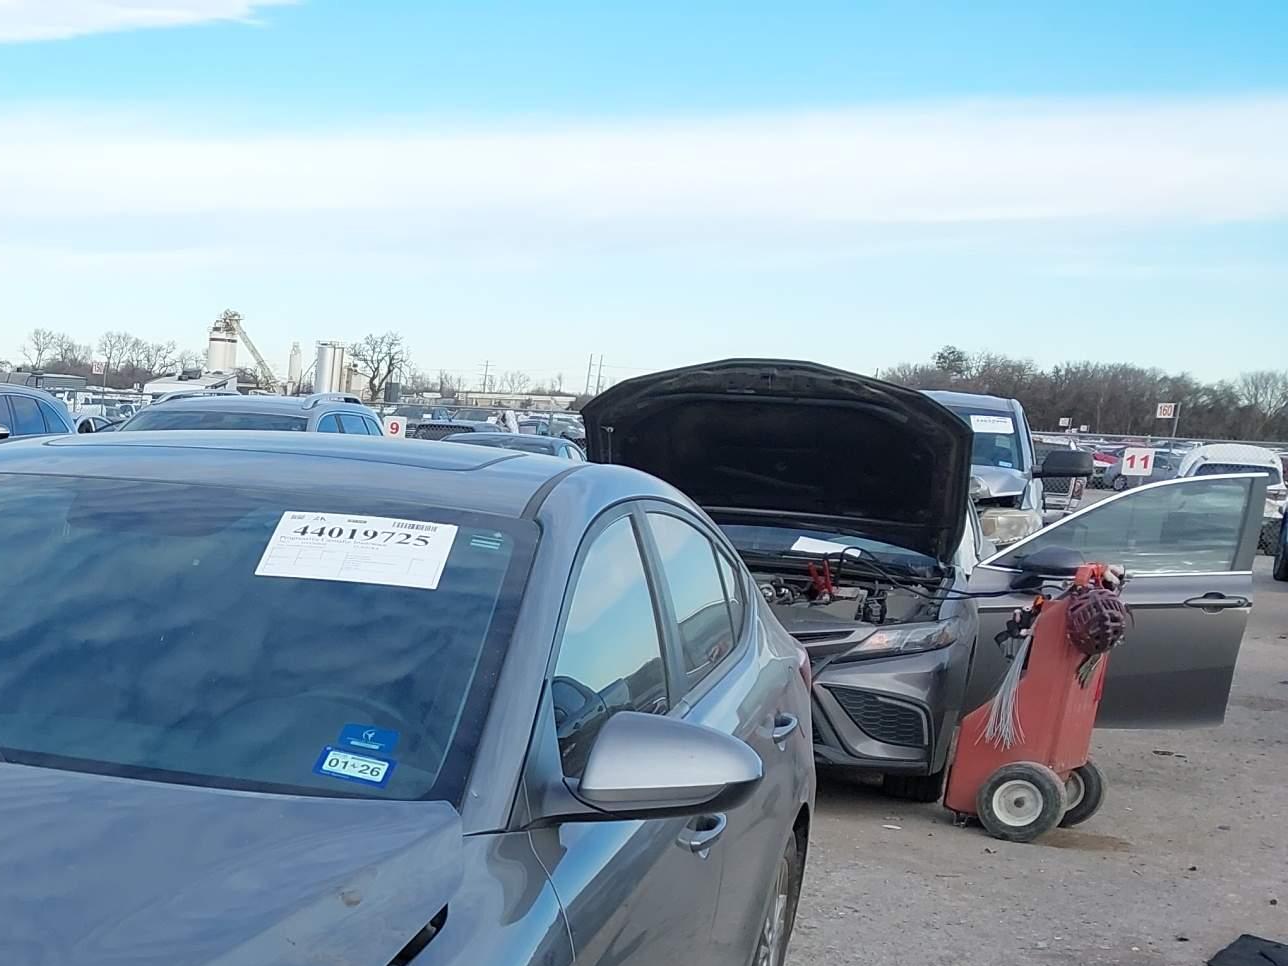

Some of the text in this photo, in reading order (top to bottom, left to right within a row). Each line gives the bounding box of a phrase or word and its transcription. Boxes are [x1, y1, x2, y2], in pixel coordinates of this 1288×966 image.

[1159, 405, 1173, 417] 160
[389, 421, 400, 435] 9
[1126, 454, 1150, 469] 11
[293, 524, 432, 547] 44019725
